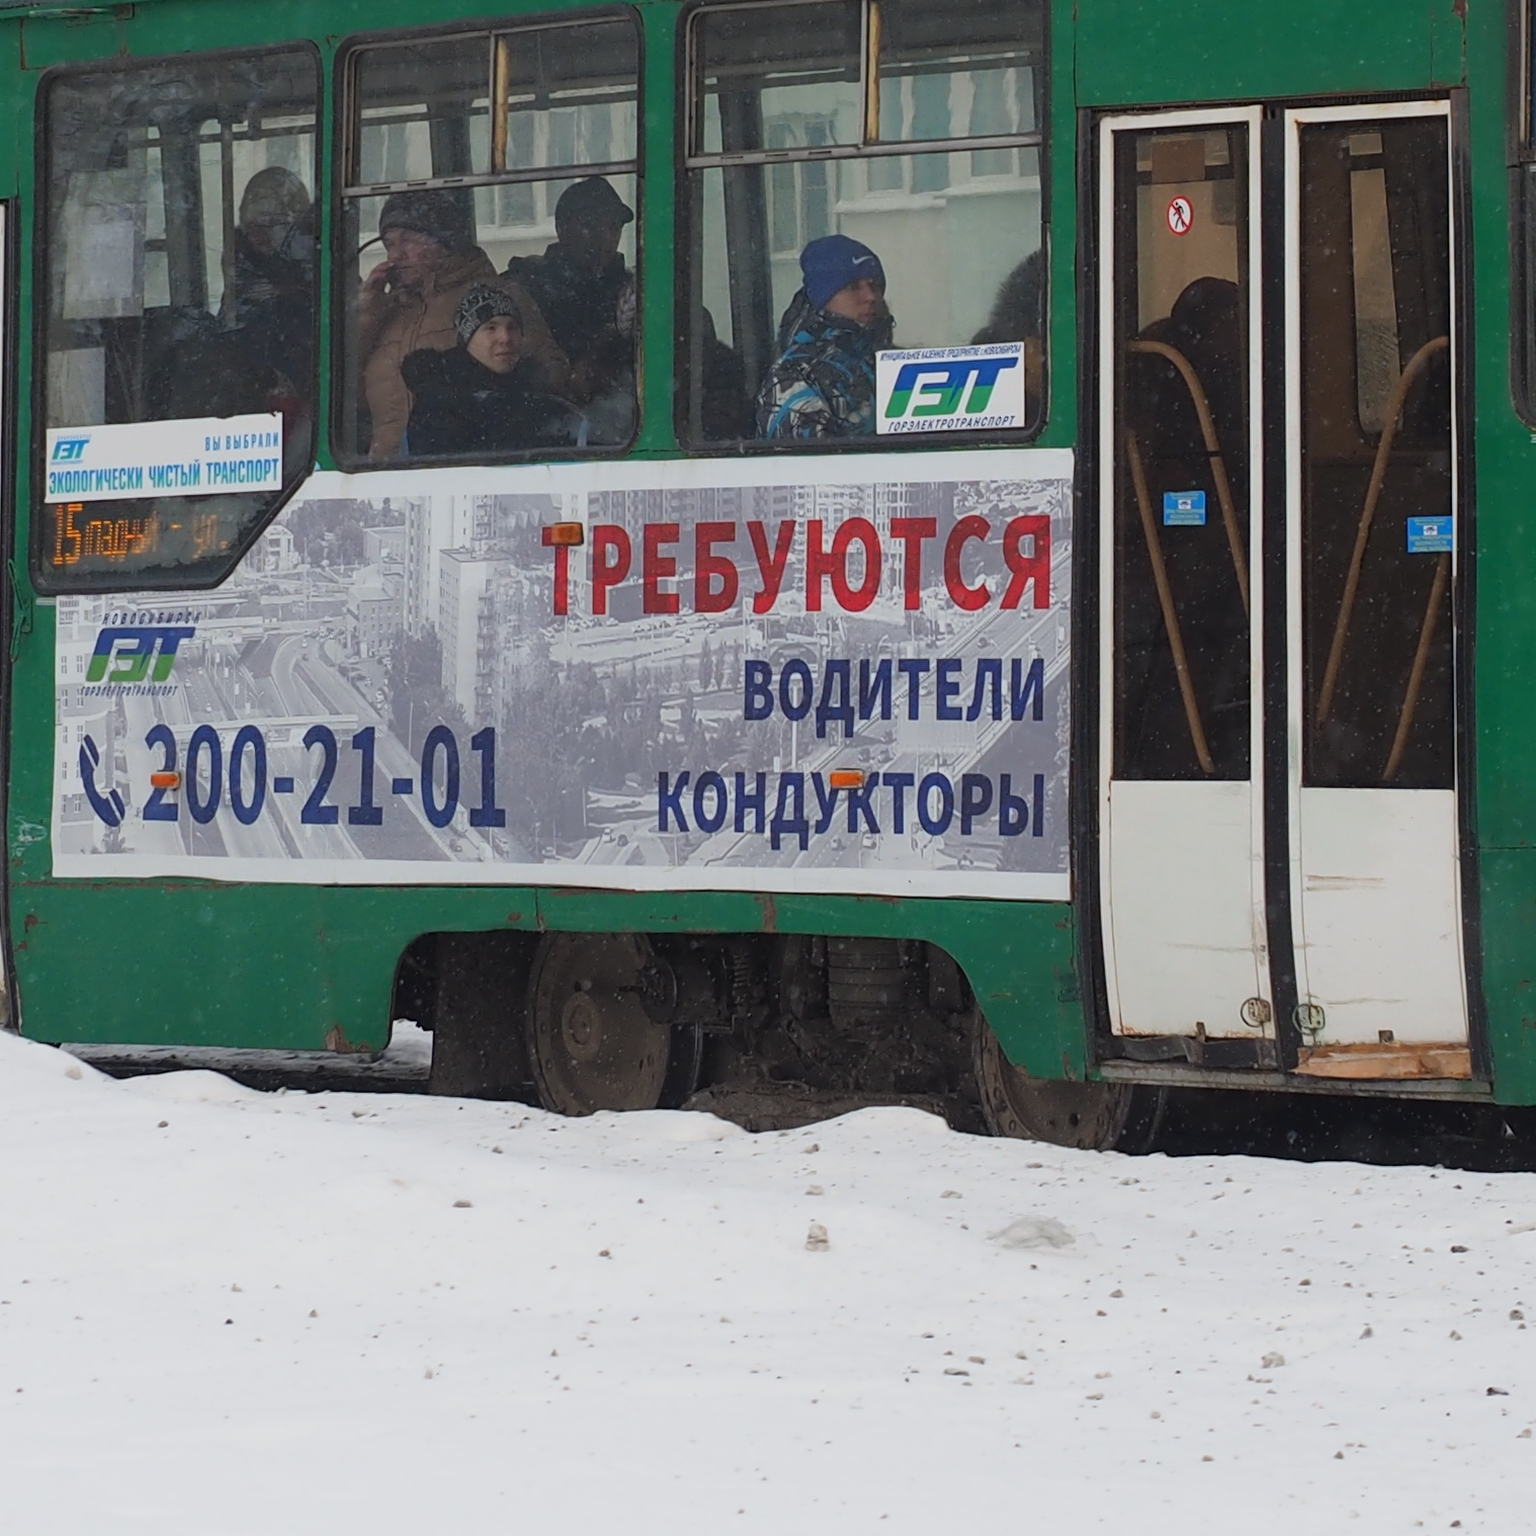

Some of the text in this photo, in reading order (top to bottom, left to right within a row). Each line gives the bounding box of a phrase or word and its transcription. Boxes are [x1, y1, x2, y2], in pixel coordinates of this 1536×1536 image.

[884, 357, 1019, 418] ГЭТ
[205, 432, 279, 451] ВЫ ВЫБРАЛИ
[888, 415, 1016, 432] ГОРЭЛЕКТРОТРАНСПОРТ
[49, 458, 279, 494] ЭКОЛОГИЧЕСКИ ЧИСТЫЙ ТРАНСПОРТ
[54, 503, 83, 564] 15
[542, 516, 1052, 615] ТРЕБУЮТСЯ
[102, 611, 203, 624] НОВОСИБИРСК
[85, 626, 196, 682] ГЭТ
[80, 685, 179, 697] ГОРЭЛЕКТРОТРАНСПОРТ
[743, 658, 1045, 738] ВОДИТЕЛИ
[143, 725, 507, 828] 200-21-01
[657, 772, 1045, 851] КОНДУКТОРЫ
